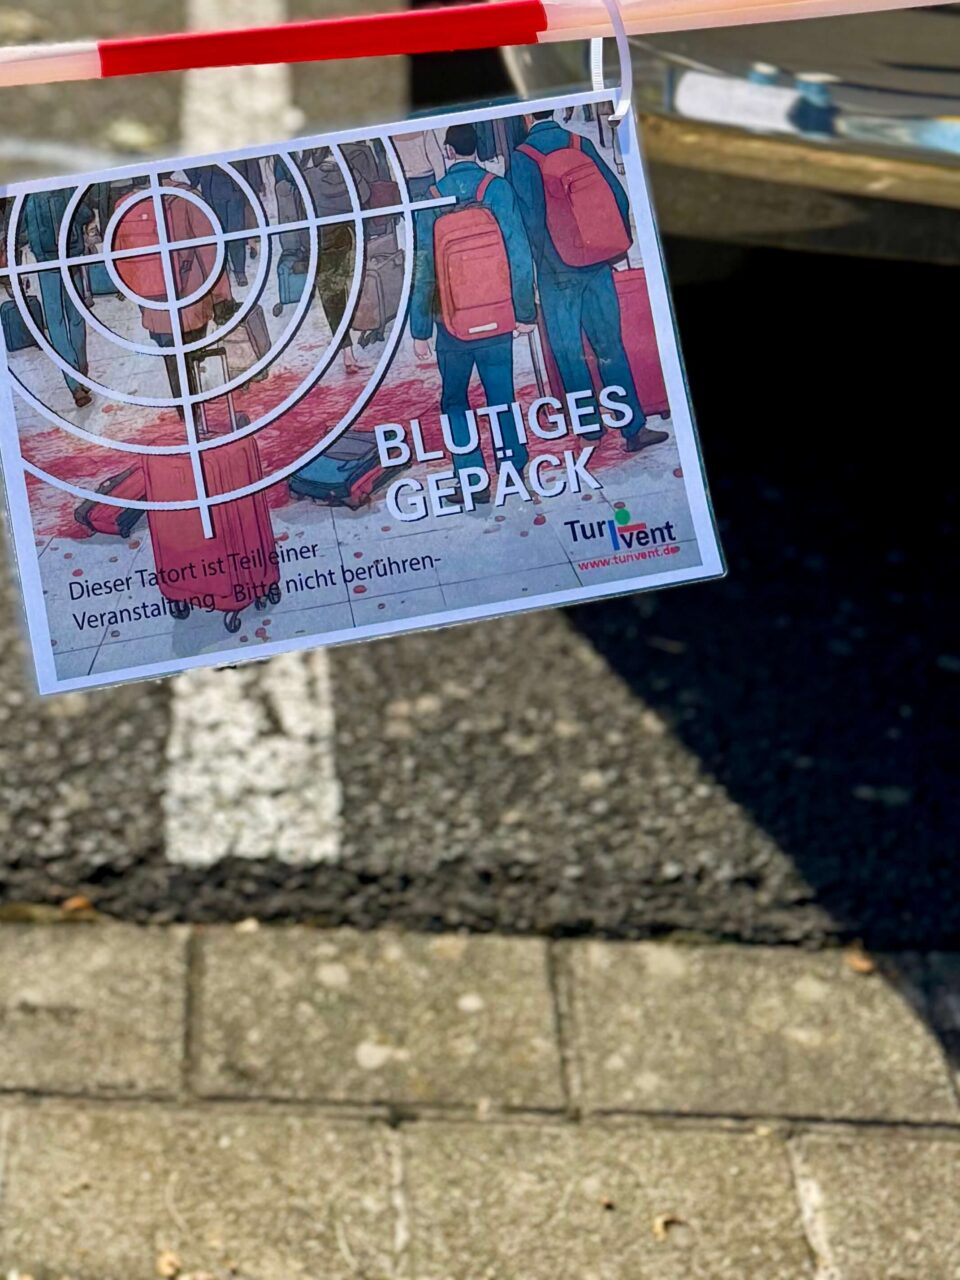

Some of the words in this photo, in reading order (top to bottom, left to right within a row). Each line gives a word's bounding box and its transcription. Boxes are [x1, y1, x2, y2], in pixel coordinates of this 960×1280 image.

[374, 384, 634, 468] BLUTIGES
[385, 446, 603, 522] GEPÄCK
[69, 575, 132, 601] Dieser
[135, 563, 197, 588] Tatort
[201, 558, 226, 577] ist
[227, 548, 265, 570] Teil
[268, 542, 318, 565] einer
[72, 593, 216, 631] Veranstaltung
[233, 581, 280, 603] Bitte
[285, 568, 337, 594] nicht
